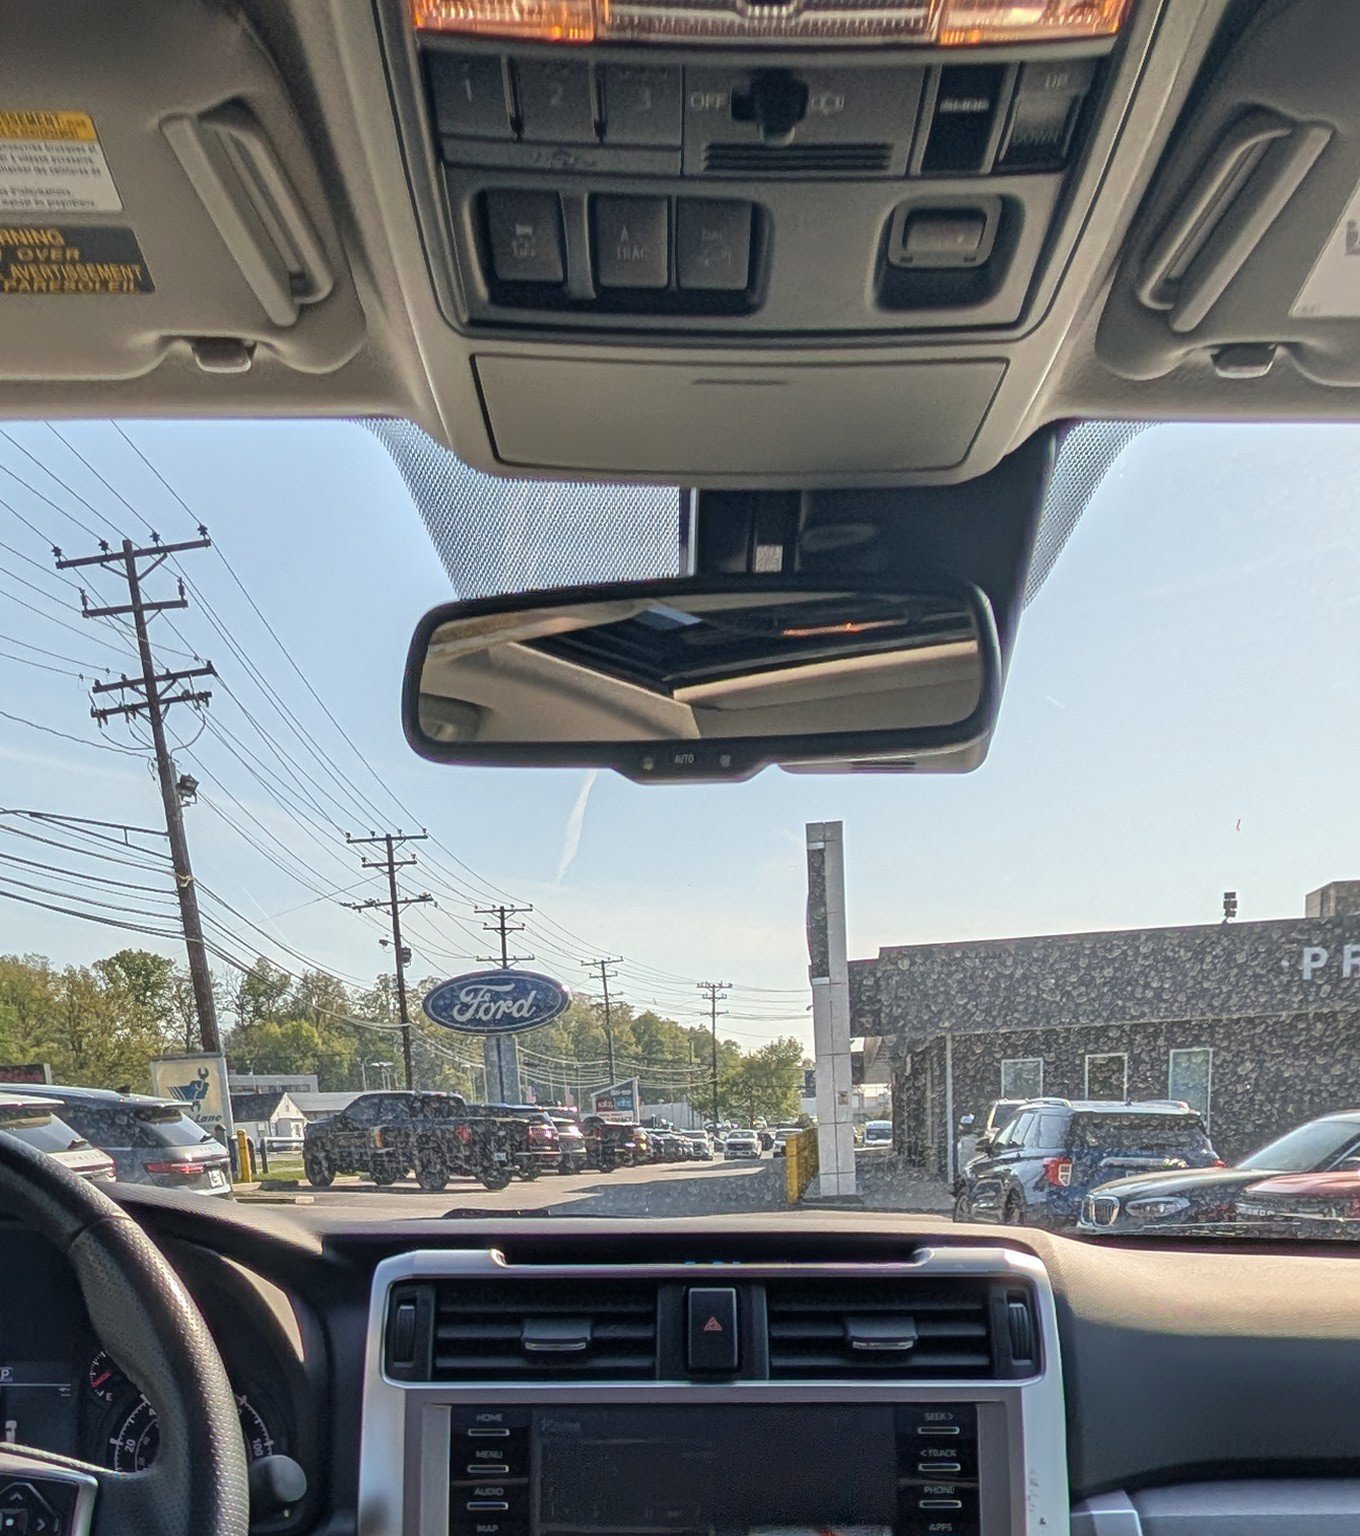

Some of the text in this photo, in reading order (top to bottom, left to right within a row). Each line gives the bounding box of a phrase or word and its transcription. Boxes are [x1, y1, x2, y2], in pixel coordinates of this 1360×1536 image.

[16, 247, 81, 262] OVER
[674, 753, 695, 764] AUTO
[452, 982, 538, 1023] Ford
[476, 1413, 503, 1422] HOME
[124, 1438, 137, 1453] 20
[251, 1437, 264, 1456] 100
[475, 1450, 504, 1459] MENU
[474, 1487, 505, 1496] AUDIO
[476, 1524, 499, 1533] MAP
[929, 1523, 953, 1532] APPS
